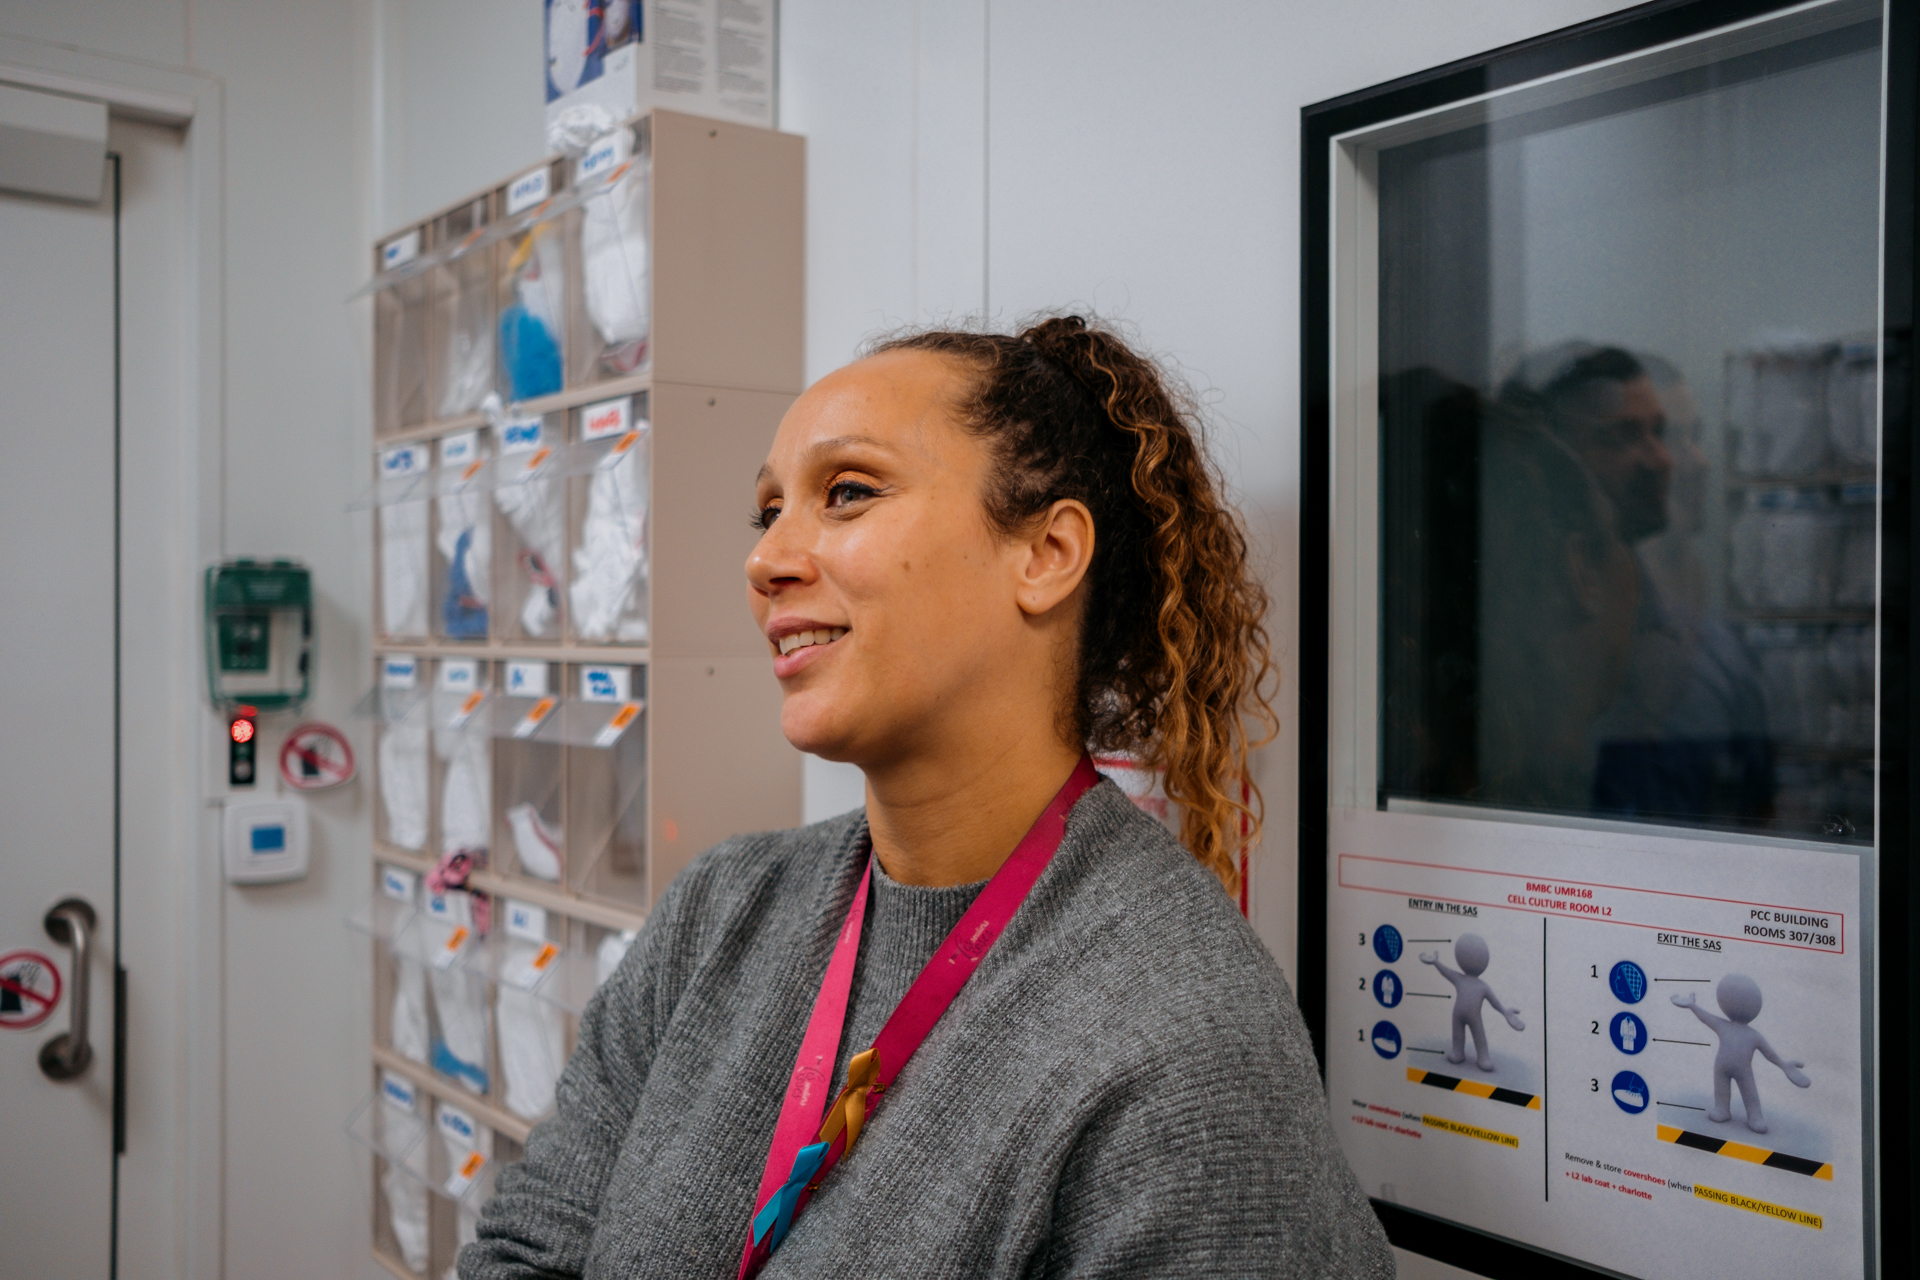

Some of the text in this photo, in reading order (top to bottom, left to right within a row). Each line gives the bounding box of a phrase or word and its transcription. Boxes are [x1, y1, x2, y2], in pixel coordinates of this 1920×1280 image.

[1526, 882, 1593, 899] BMBC UMR168
[1408, 898, 1478, 916] ENTRY IN THE SAS
[1507, 894, 1612, 916] CELL CULTURE ROOM L2
[1750, 909, 1829, 929] PCC BUILDING
[1358, 933, 1366, 945] 3
[1657, 932, 1722, 951] EXIT THE SAS
[1743, 924, 1836, 947] ROOMS 307/308
[1590, 964, 1599, 978] 1
[1358, 977, 1366, 990] 2
[1358, 1029, 1365, 1042] 1
[1591, 1020, 1600, 1035] 2
[1590, 1078, 1599, 1093] 3
[1422, 1115, 1449, 1130] PASSING
[1450, 1121, 1500, 1142] BLACK/YELLOW
[1500, 1136, 1519, 1148] LINE)
[1564, 1152, 1823, 1229] Remove & store covershoes (when PASSING BLACK/YELLOW LINE)
[1570, 1171, 1580, 1181] L2
[1581, 1173, 1593, 1184] lab
[1594, 1177, 1611, 1188] coat
[1618, 1182, 1653, 1201] charlotte
